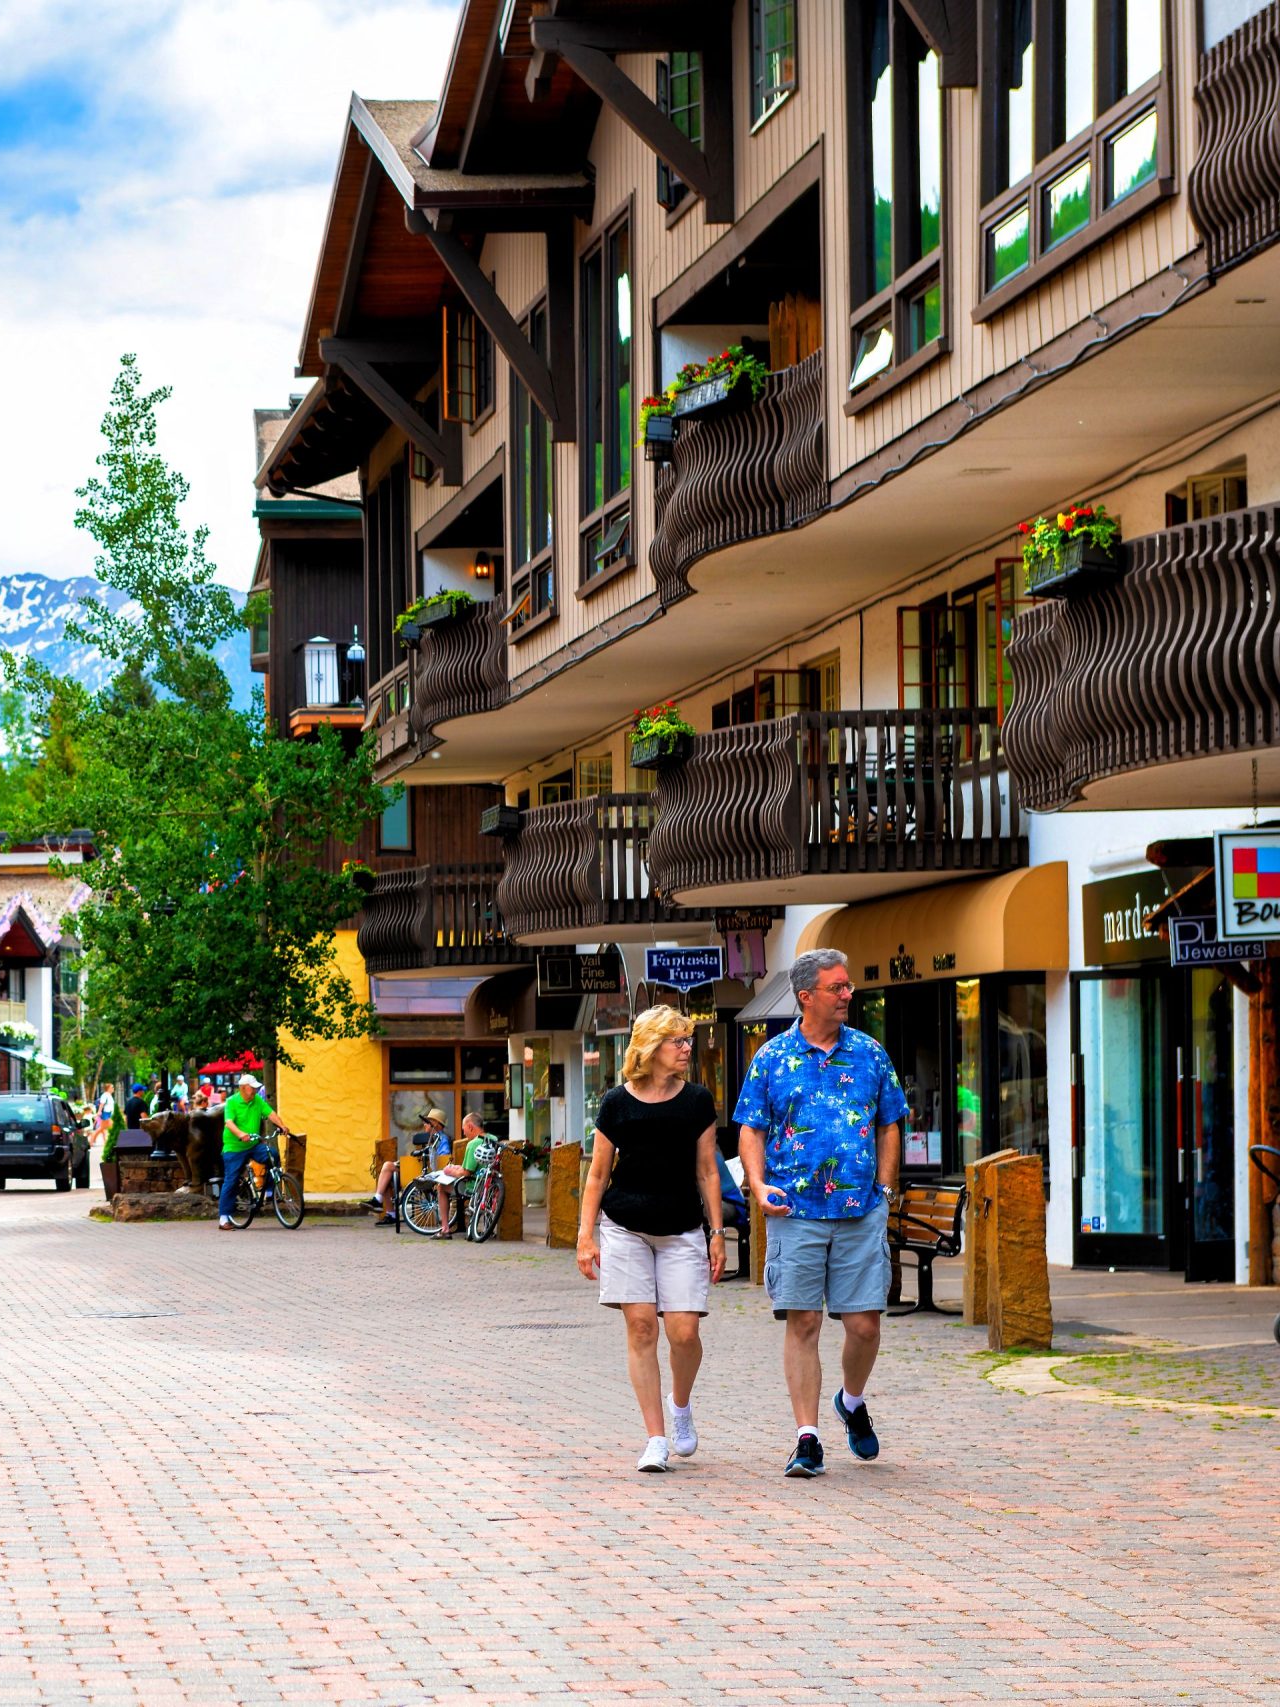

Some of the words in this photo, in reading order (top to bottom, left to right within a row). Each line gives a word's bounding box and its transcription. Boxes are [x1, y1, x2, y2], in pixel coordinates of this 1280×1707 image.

[1175, 921, 1218, 961] PL
[1181, 943, 1263, 961] Jewelers
[580, 956, 601, 966] Vail
[652, 953, 718, 967] Fantasia
[581, 967, 605, 978] Fine
[669, 968, 706, 980] Furs
[581, 978, 617, 990] Wines
